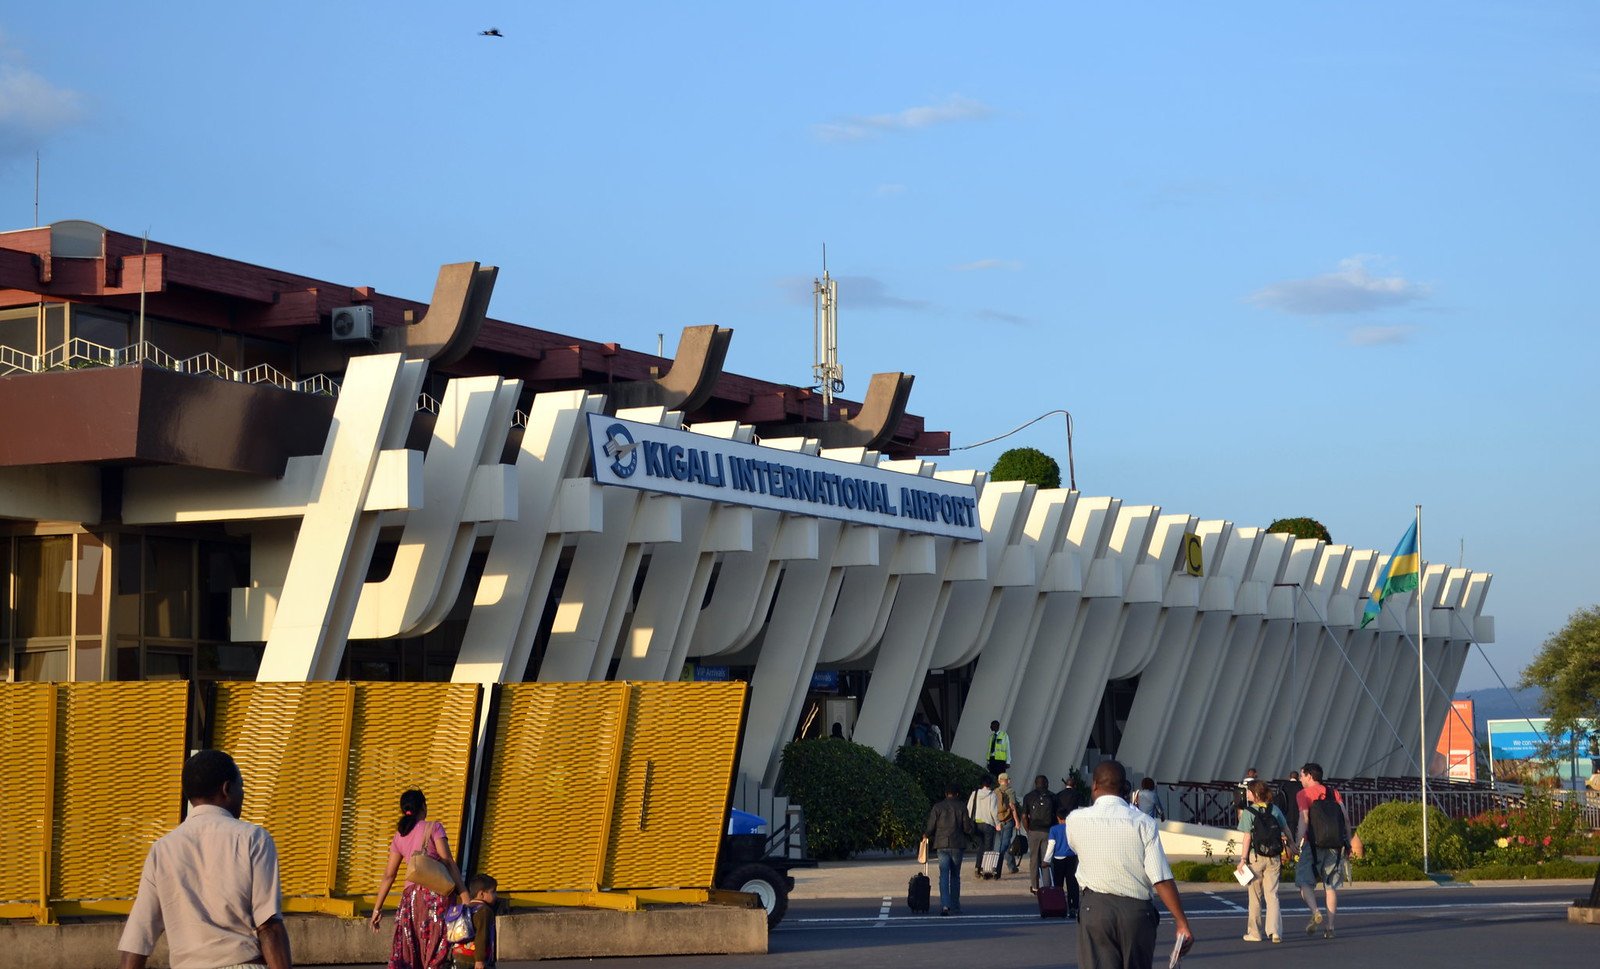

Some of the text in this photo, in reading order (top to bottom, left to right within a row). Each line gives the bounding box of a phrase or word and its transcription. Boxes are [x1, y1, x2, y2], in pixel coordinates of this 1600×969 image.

[642, 440, 726, 488] KIGALI
[729, 456, 897, 517] INTERNATIONAL
[901, 487, 977, 528] AIRPORT
[1188, 537, 1201, 572] C
[706, 667, 726, 678] Arrivals
